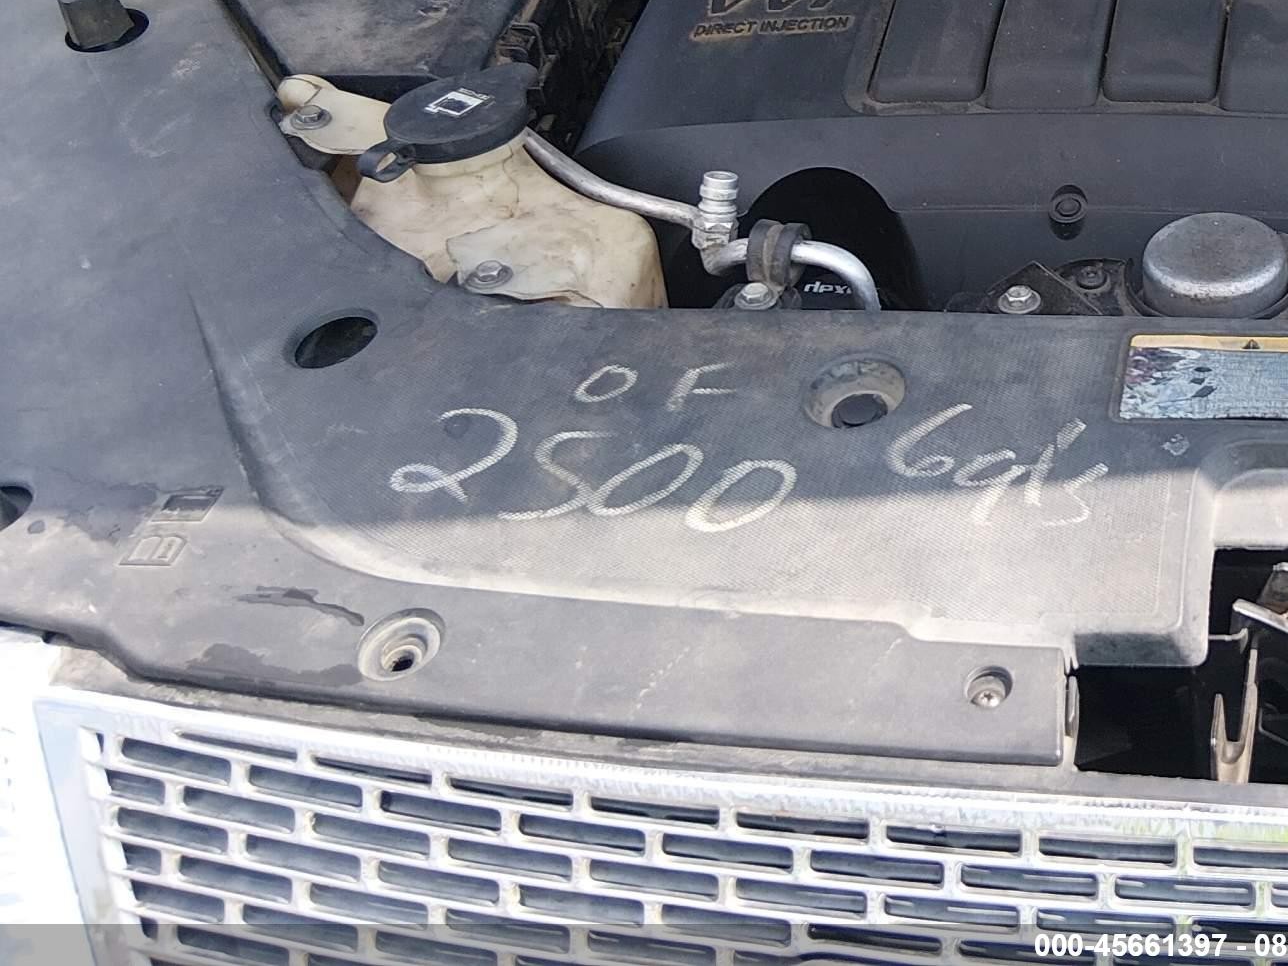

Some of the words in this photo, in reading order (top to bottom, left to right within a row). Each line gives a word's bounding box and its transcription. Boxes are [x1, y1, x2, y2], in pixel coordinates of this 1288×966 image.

[693, 20, 757, 38] DIRECT
[759, 16, 849, 33] INJECTION
[388, 407, 798, 533] 2500
